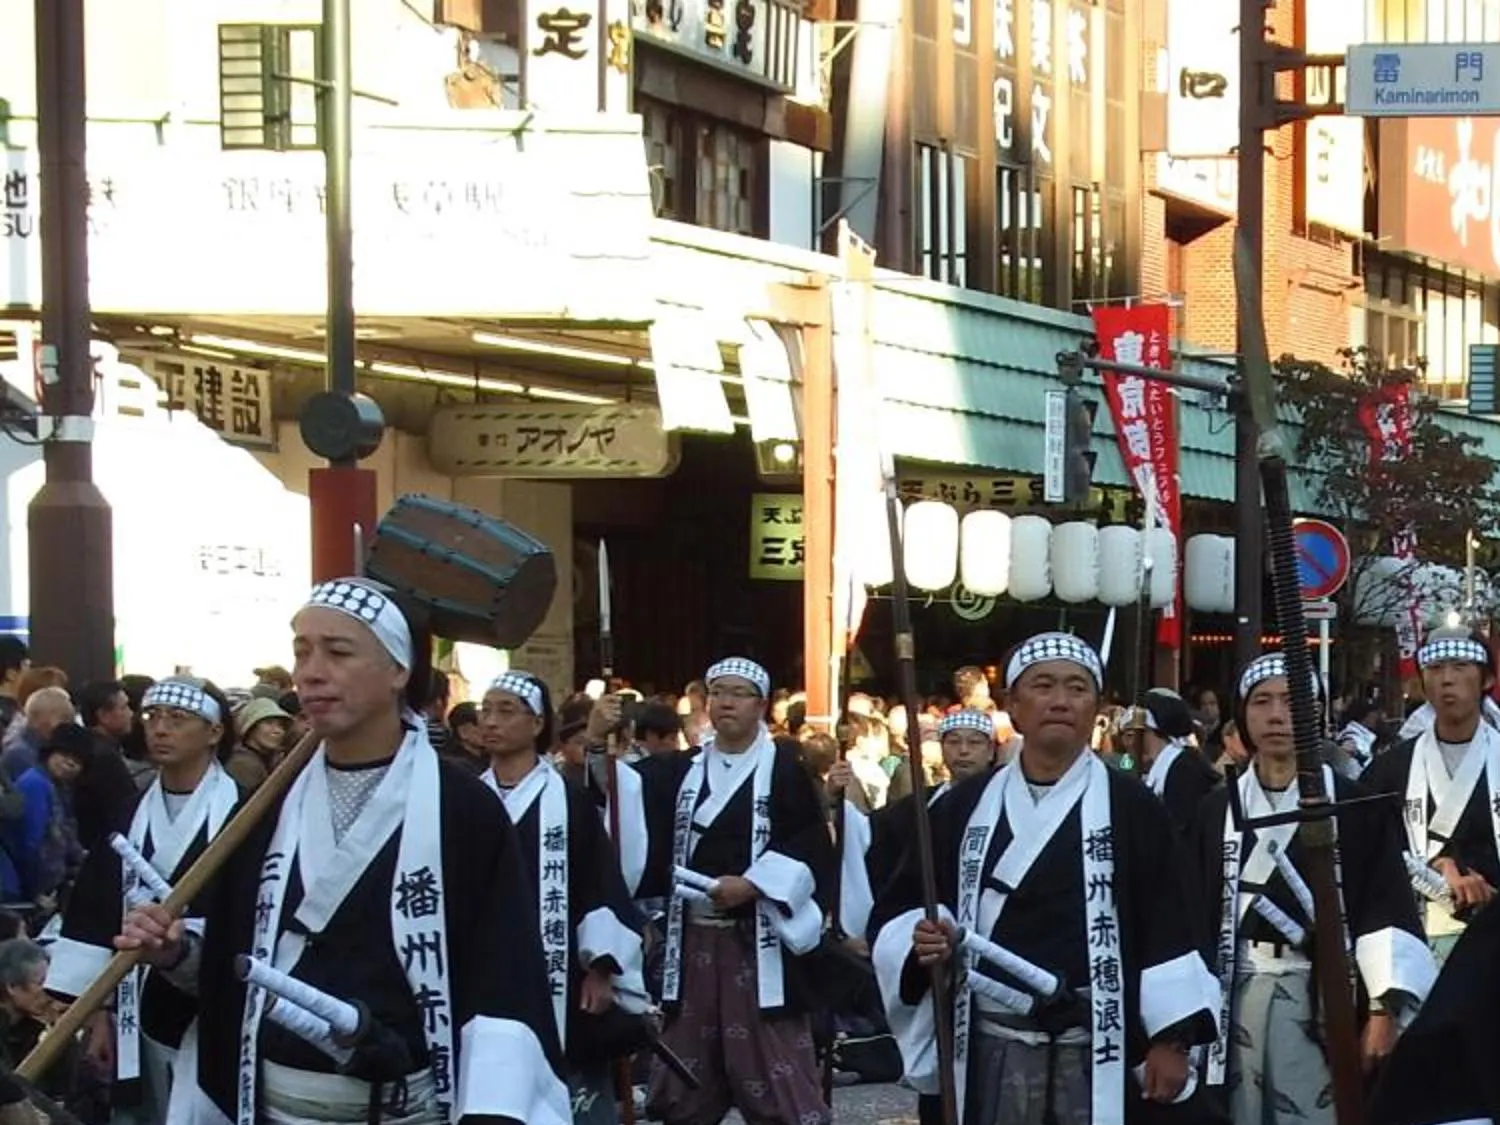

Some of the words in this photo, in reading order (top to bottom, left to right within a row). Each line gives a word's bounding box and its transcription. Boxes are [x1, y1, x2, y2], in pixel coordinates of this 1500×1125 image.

[1373, 52, 1483, 83] 雷門
[1375, 88, 1480, 105] Kaminarimon
[1084, 826, 1122, 1065] 播州赤穂浪士
